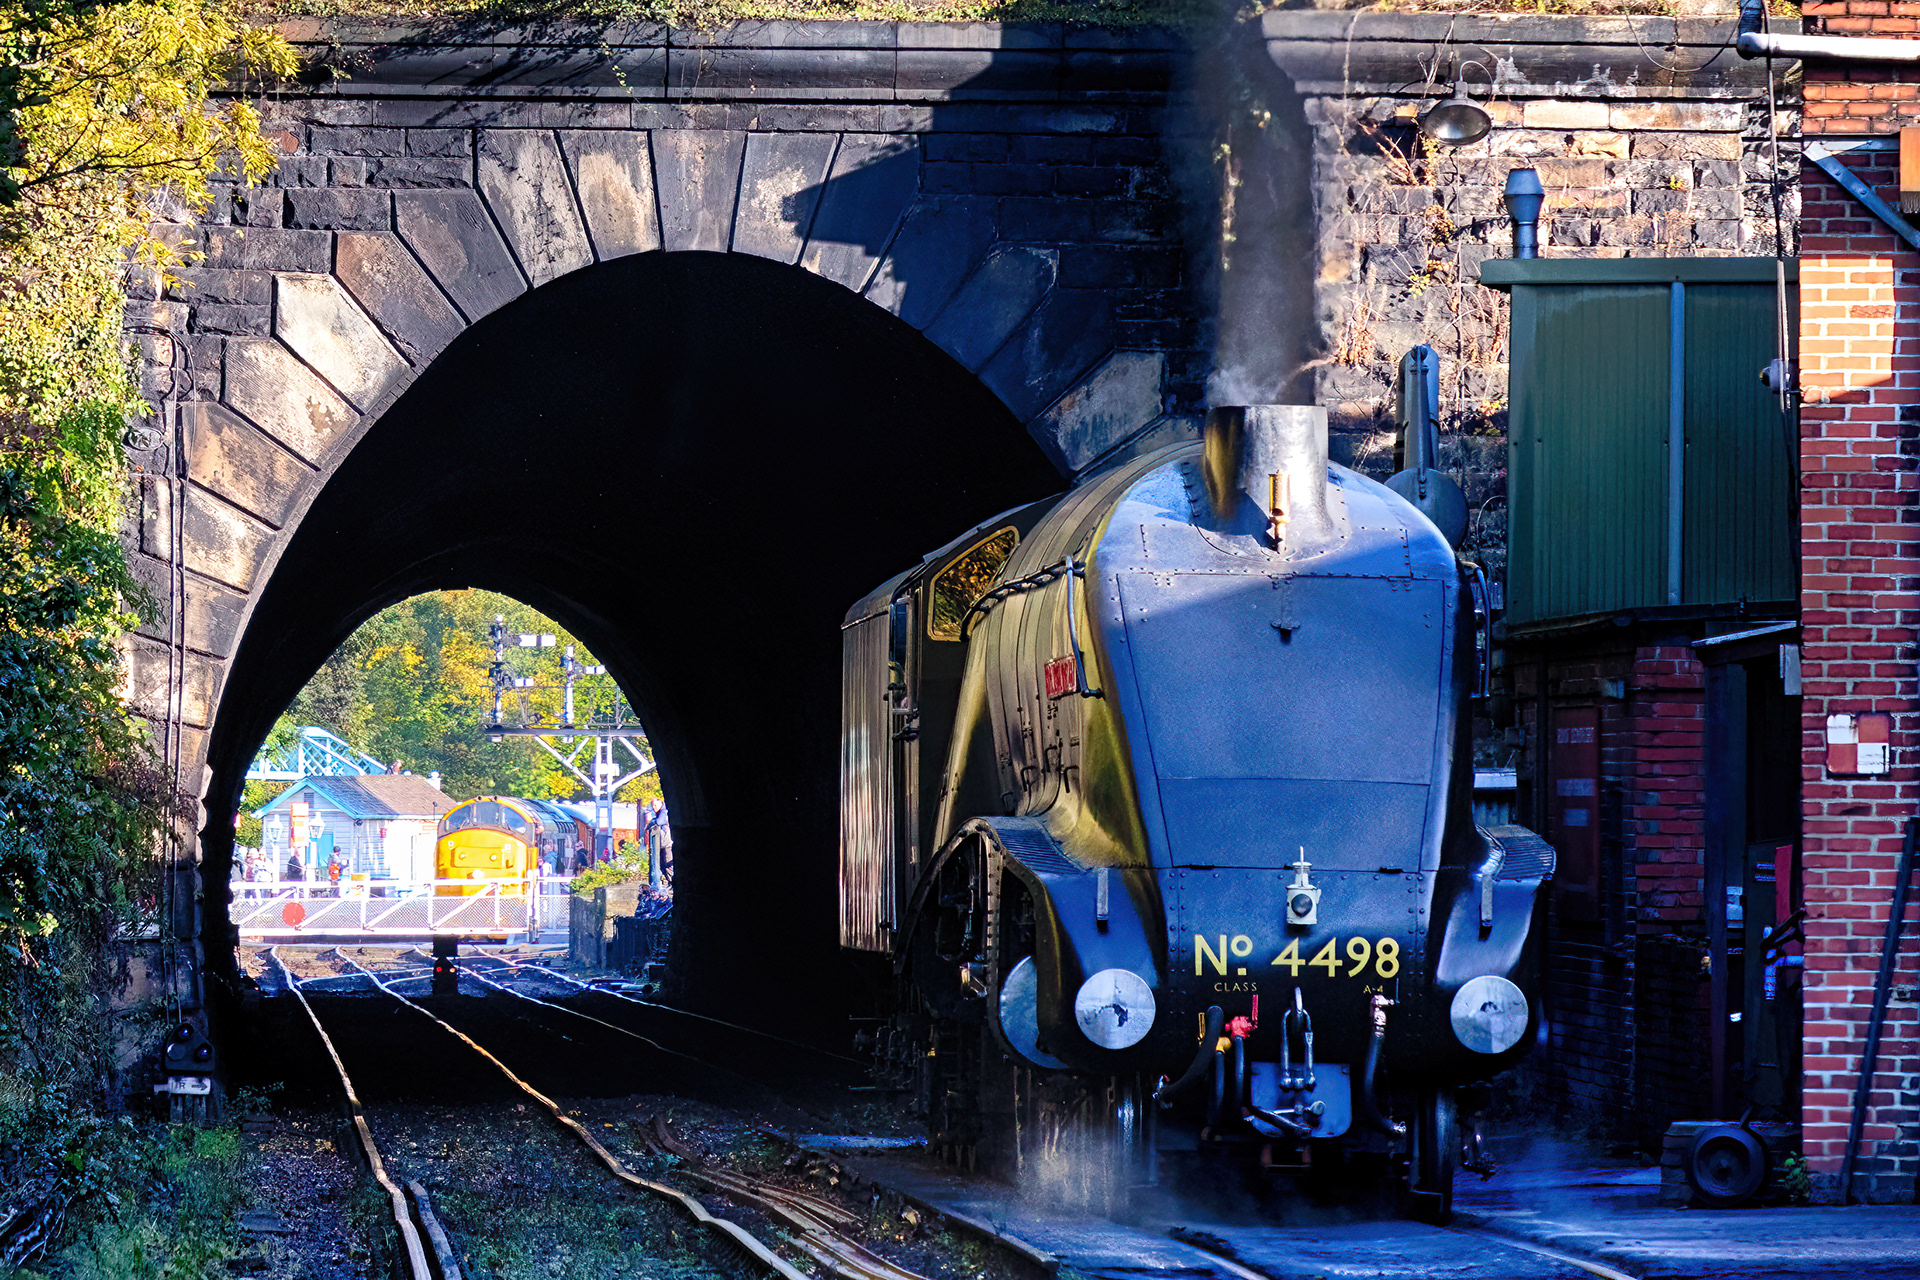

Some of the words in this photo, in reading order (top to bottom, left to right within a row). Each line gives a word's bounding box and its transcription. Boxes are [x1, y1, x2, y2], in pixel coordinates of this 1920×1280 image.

[1271, 936, 1400, 979] 4498
[1214, 982, 1258, 992] CLASS
[1363, 984, 1384, 994] A-4
